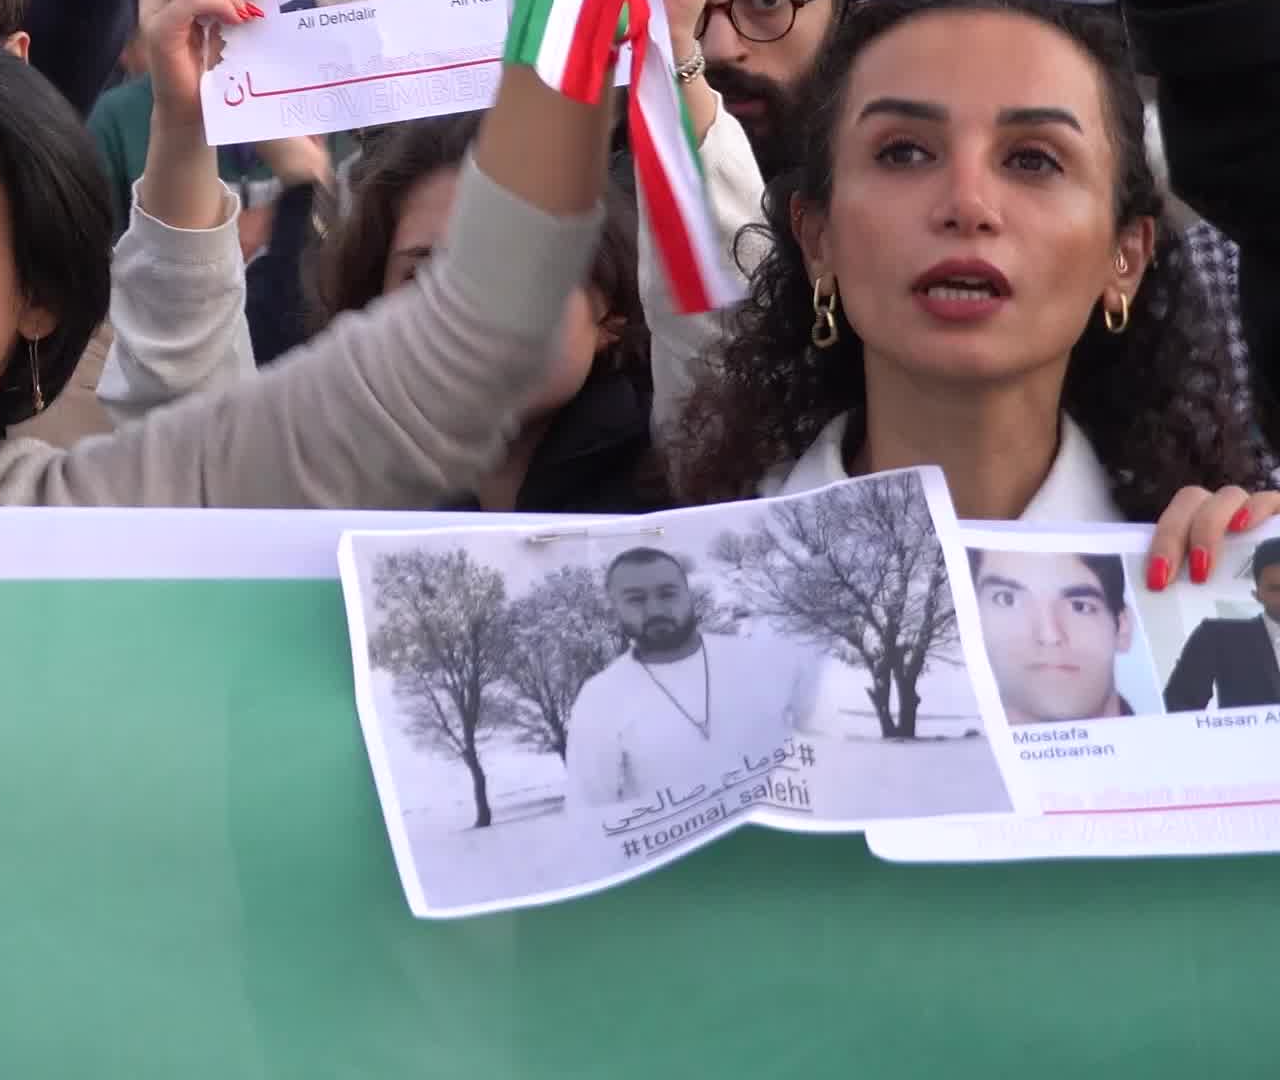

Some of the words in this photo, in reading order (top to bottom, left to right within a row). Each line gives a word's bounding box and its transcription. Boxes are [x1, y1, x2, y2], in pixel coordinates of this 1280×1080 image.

[297, 16, 315, 30] Ali
[1196, 715, 1257, 729] Hasan
[1012, 726, 1088, 745] Mostafa
